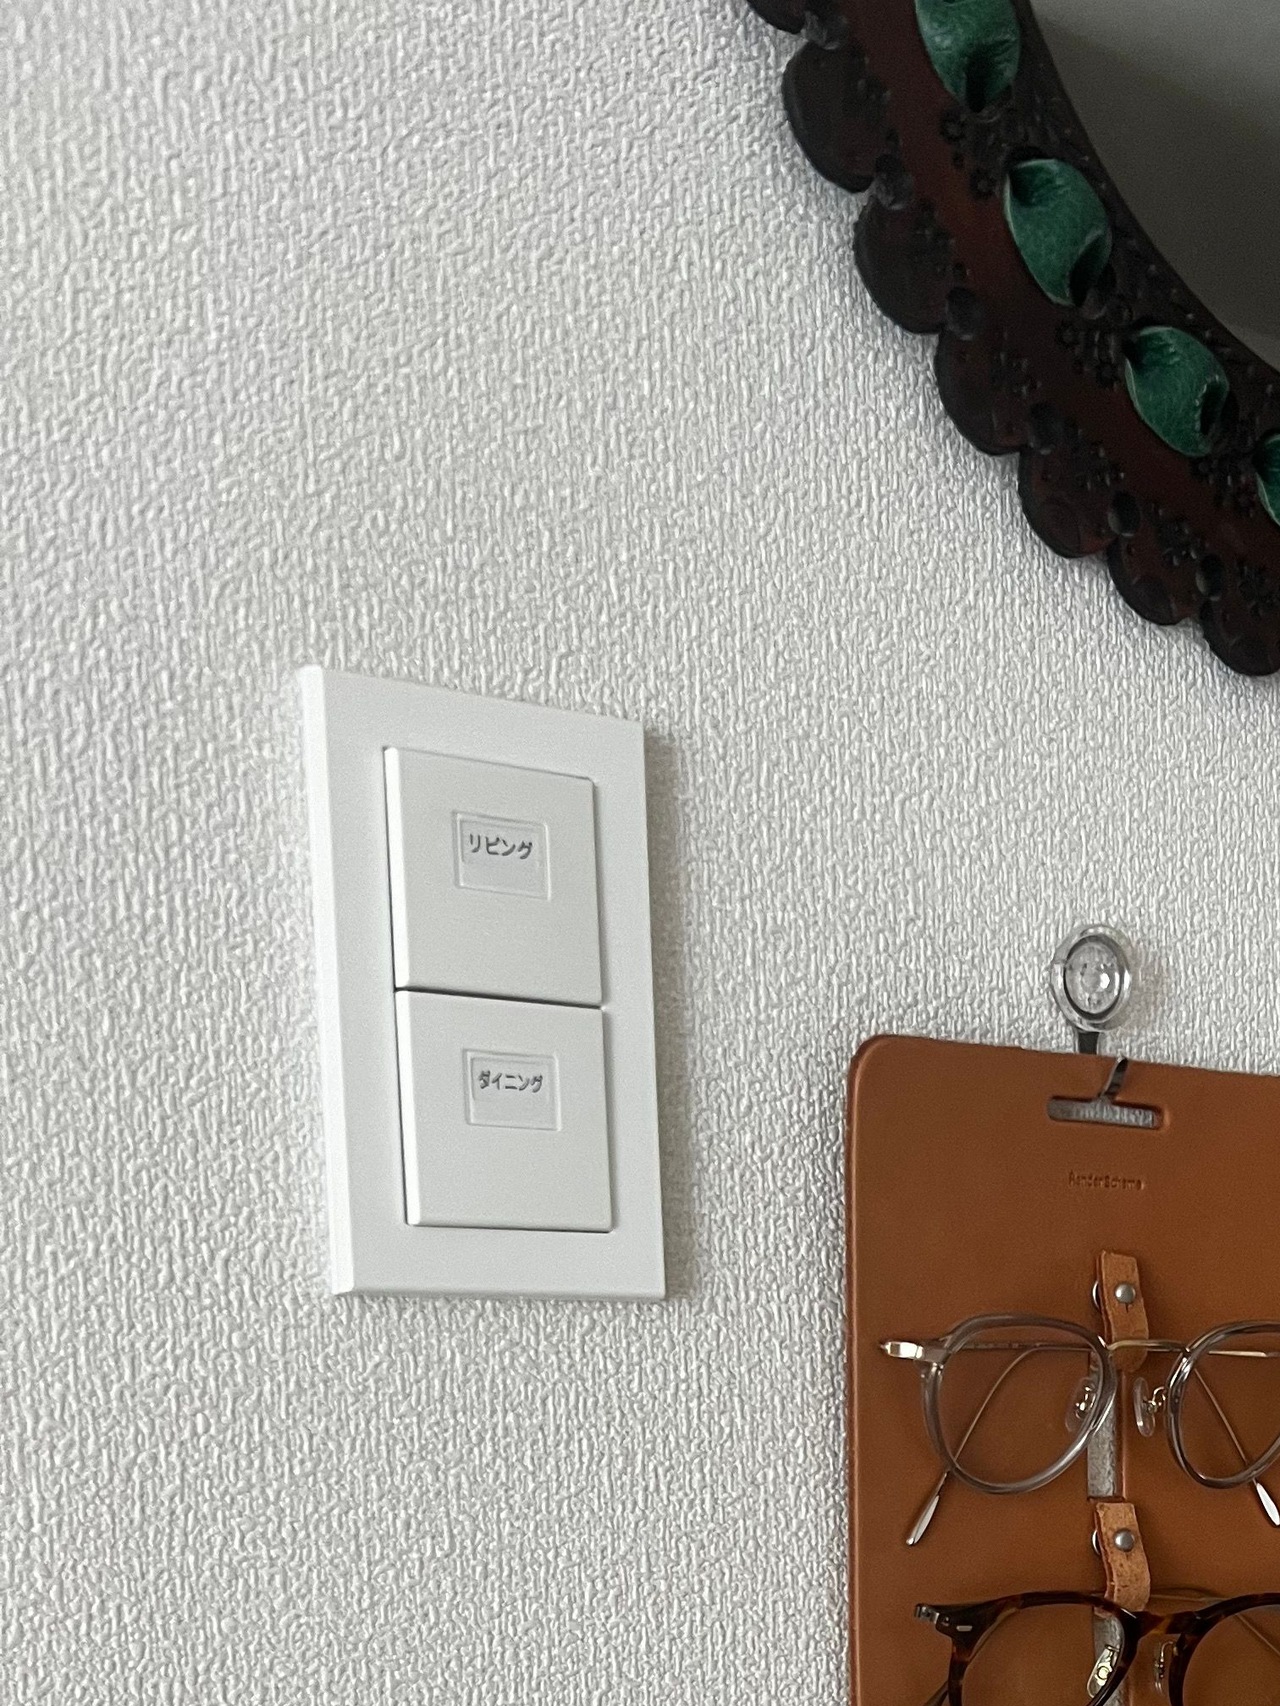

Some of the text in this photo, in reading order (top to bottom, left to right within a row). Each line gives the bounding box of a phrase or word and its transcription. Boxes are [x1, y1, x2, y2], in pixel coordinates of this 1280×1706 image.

[478, 1069, 544, 1094] ダイニング
